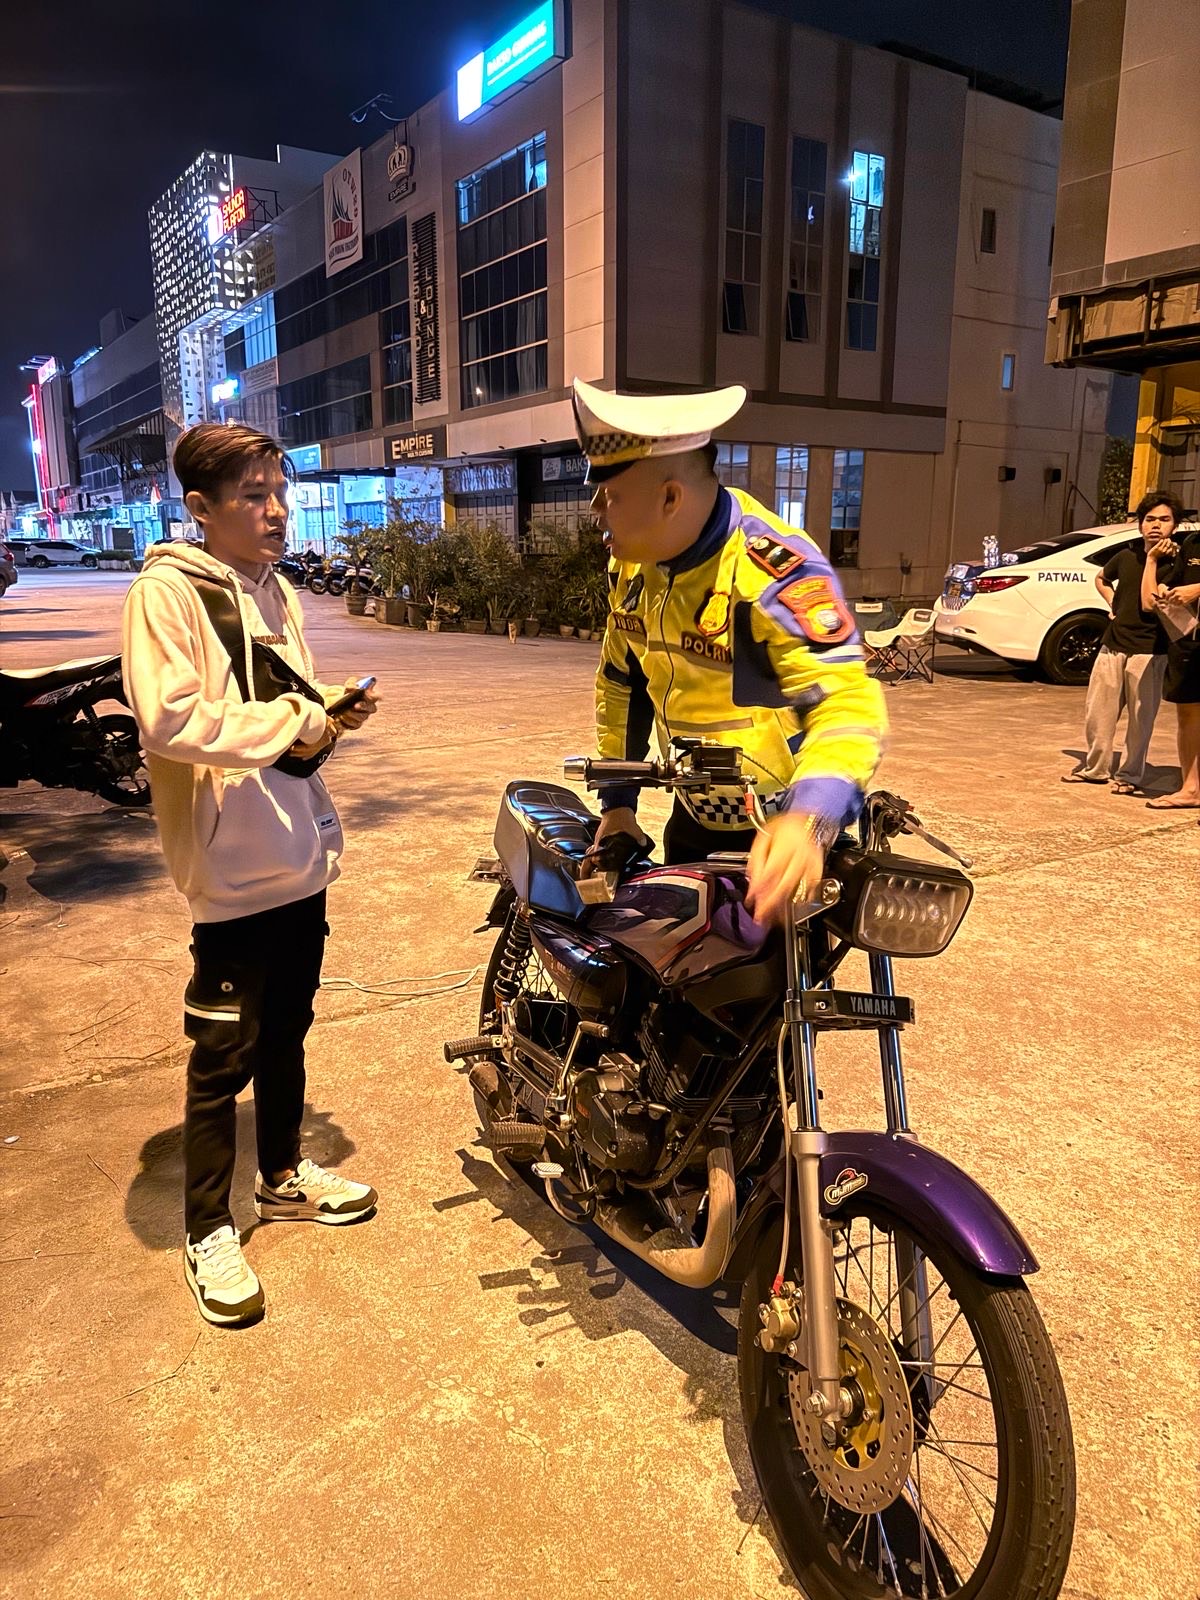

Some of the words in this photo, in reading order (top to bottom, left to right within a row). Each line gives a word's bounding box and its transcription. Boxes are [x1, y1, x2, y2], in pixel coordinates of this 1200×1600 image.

[425, 267, 436, 378] LOUNGE
[392, 432, 433, 460] EMPIRE
[1037, 571, 1088, 583] PATWAL
[850, 995, 897, 1017] YAMAHA
